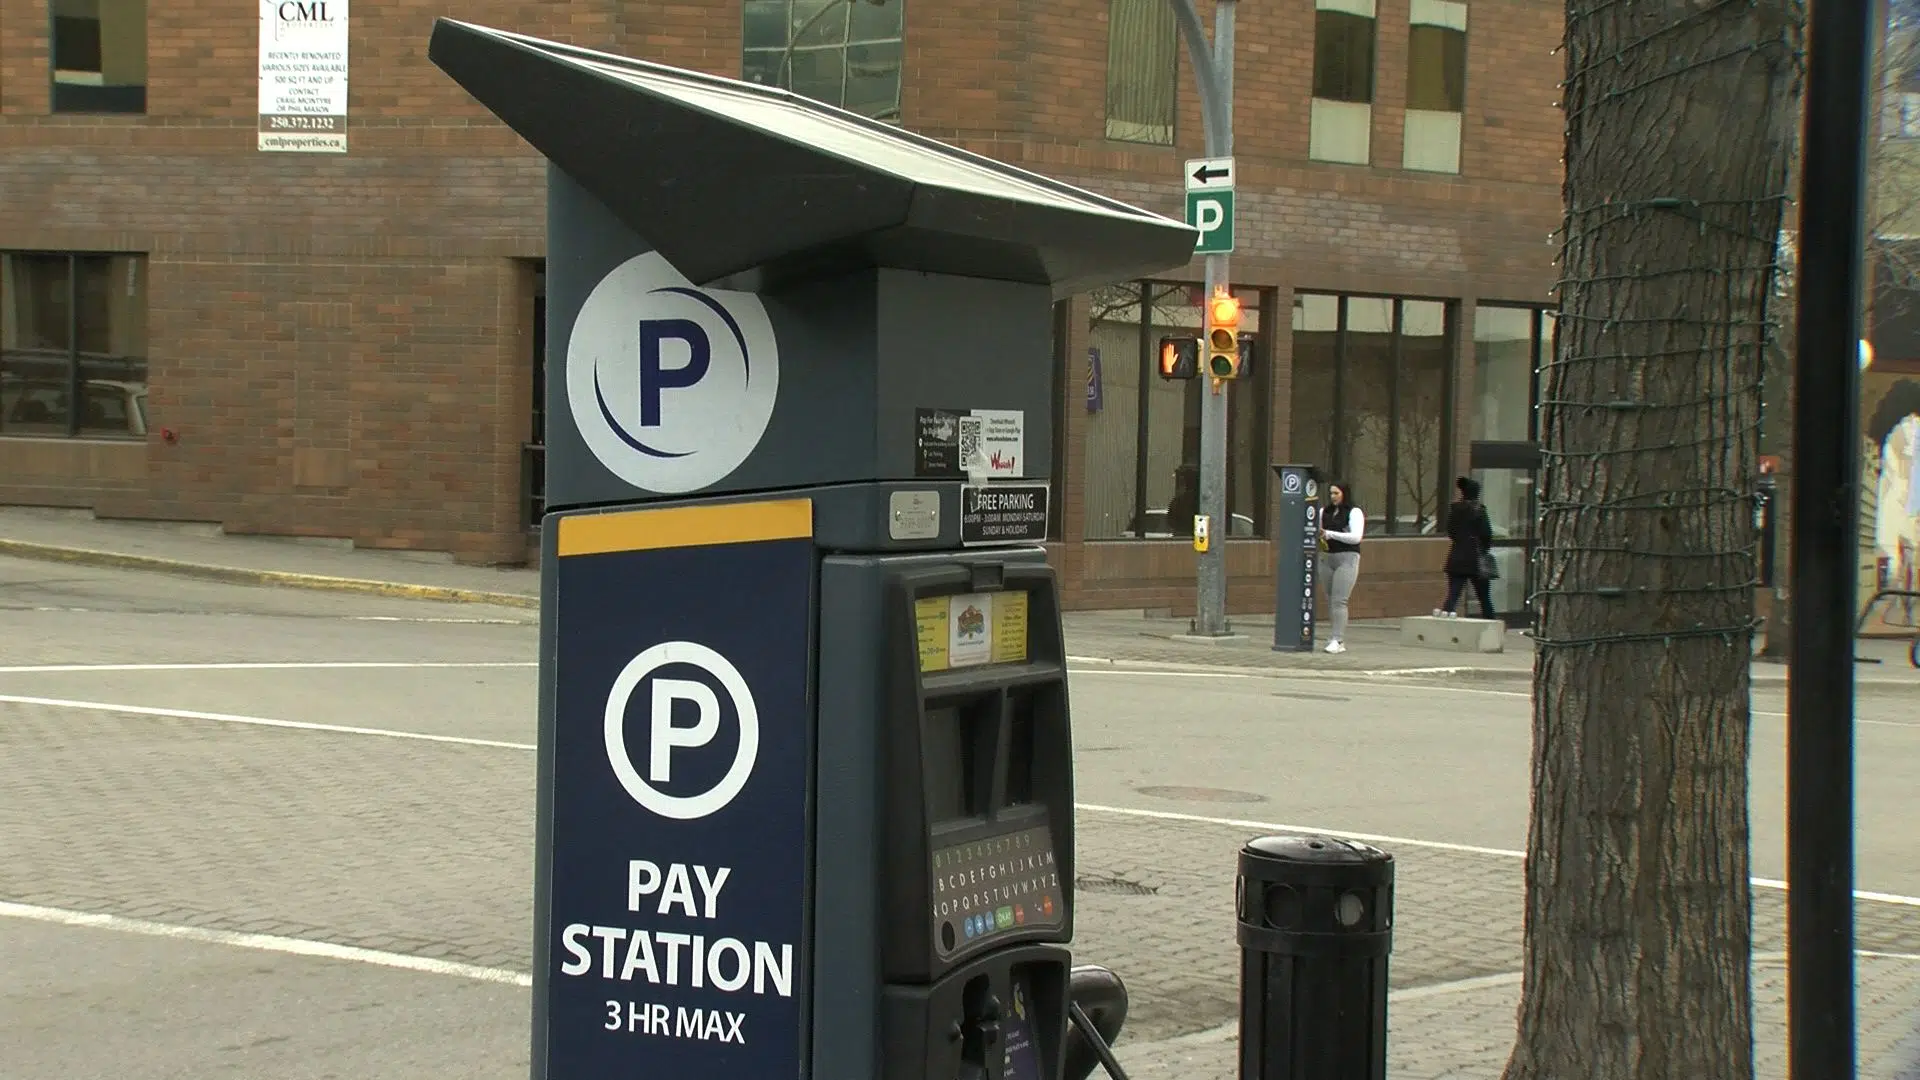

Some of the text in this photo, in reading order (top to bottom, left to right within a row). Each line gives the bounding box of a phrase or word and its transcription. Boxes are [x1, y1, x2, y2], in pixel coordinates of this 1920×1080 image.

[279, 1, 334, 22] CML
[268, 52, 341, 60] RECENTLY RENOVATED
[262, 64, 346, 72] VARIOUS SIZES AVAILABLE
[308, 76, 322, 84] AND
[324, 76, 334, 84] UP
[303, 105, 329, 113] MASON
[271, 116, 334, 129] 250.372.1232
[265, 136, 340, 149] cmlproperties.ca
[1196, 199, 1223, 246] P
[639, 318, 711, 427] P
[977, 493, 1034, 511] FREE PARKING
[982, 525, 1001, 536] SUNDAY
[1005, 525, 1028, 535] HOLIDAYS
[650, 678, 720, 782] P
[939, 851, 1054, 891] B C D E F G H I J K L M
[628, 859, 731, 919] PAY
[942, 902, 948, 915] O
[953, 899, 958, 912] P
[963, 896, 969, 909] Q
[974, 894, 980, 906] R
[984, 891, 989, 904] S
[994, 889, 998, 901] T
[1003, 887, 1009, 899] U
[1013, 884, 1018, 896] V
[1022, 881, 1028, 893] W
[1032, 879, 1038, 891] X
[1041, 876, 1046, 888] Y
[1051, 874, 1056, 887] Z
[560, 922, 793, 998] STATION
[604, 1000, 746, 1045] 3 HR MAX
